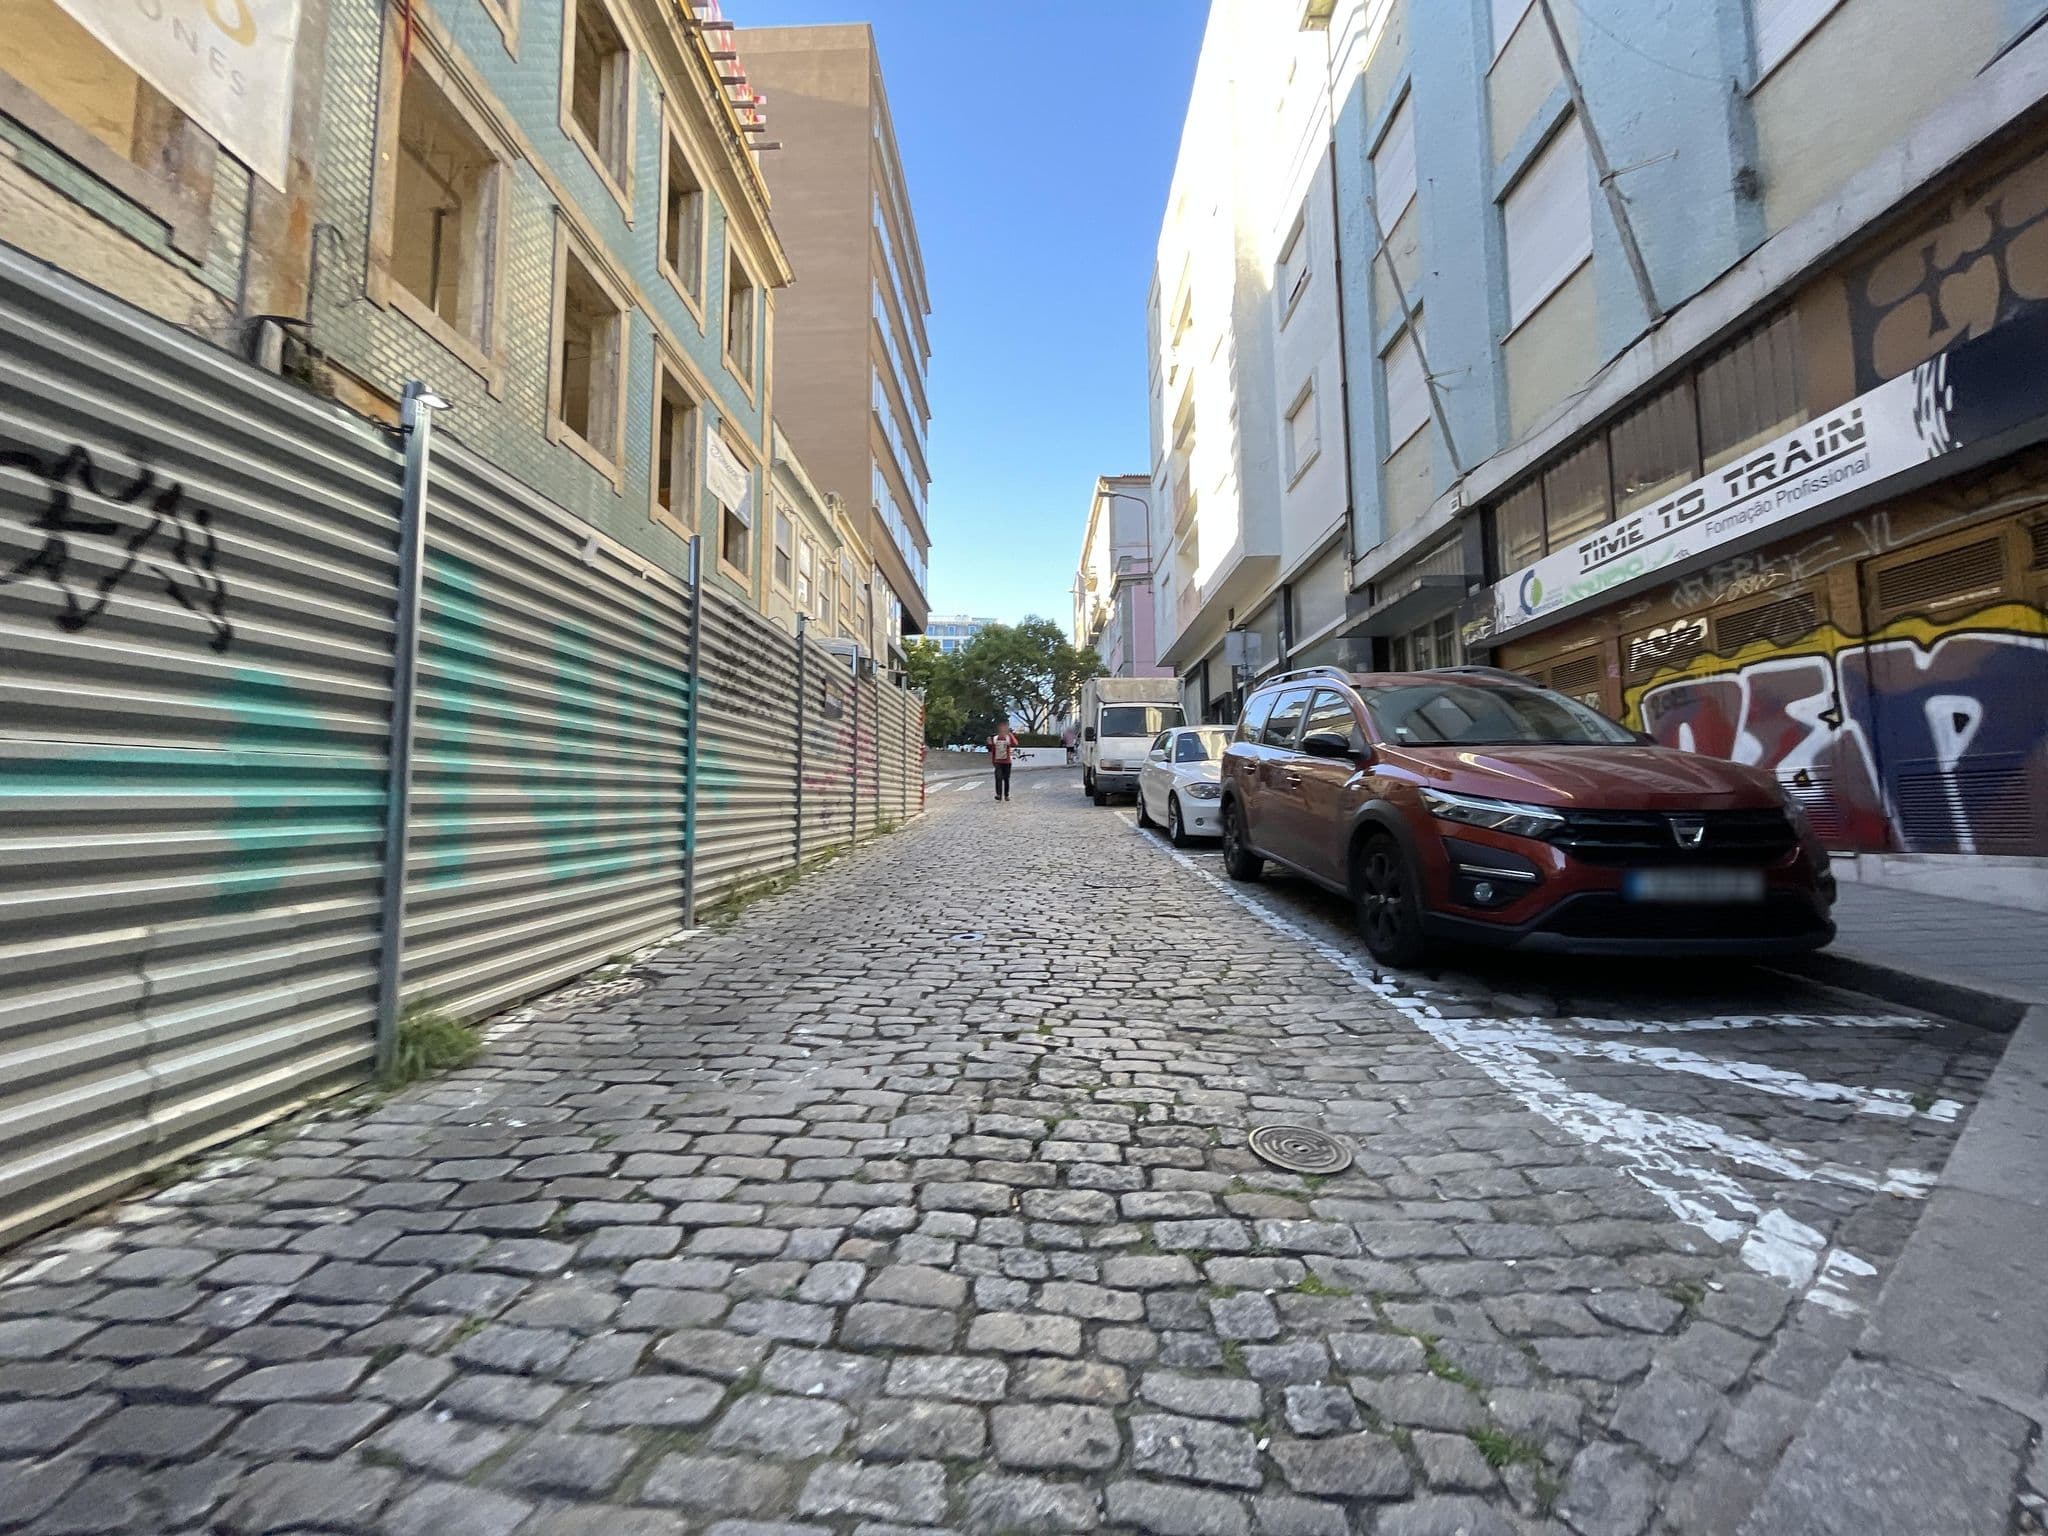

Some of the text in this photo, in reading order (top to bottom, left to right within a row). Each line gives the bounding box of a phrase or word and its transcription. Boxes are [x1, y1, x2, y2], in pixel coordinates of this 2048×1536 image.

[1579, 407, 1866, 566] TIME TO TRAIN
[1704, 452, 1870, 538] Formação Profissional
